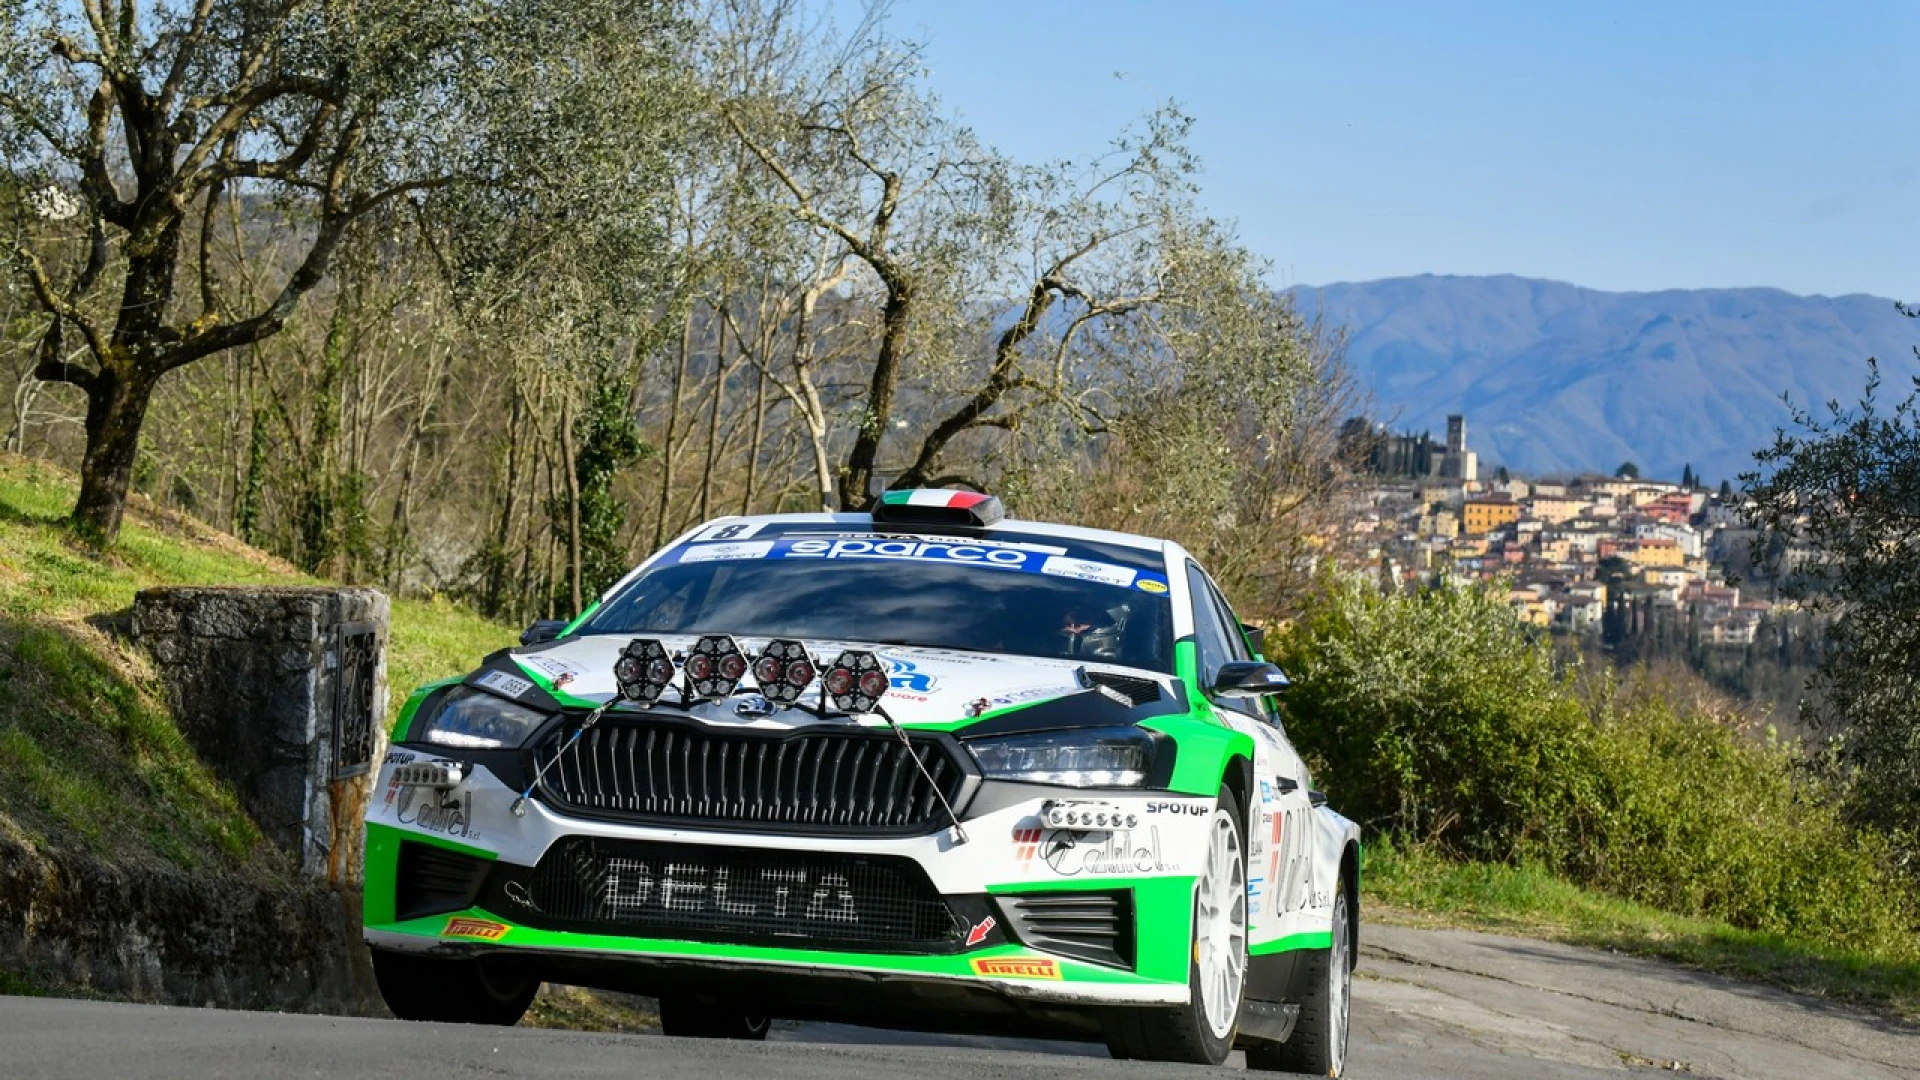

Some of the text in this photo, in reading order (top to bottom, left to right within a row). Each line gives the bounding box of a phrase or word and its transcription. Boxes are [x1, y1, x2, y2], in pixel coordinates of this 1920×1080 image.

[710, 525, 749, 539] 8
[790, 539, 1027, 565] sparco
[1146, 803, 1209, 817] SPOTUP
[604, 857, 859, 922] DELTA
[444, 919, 505, 939] PIRELLI
[977, 959, 1054, 977] PIRELLI
